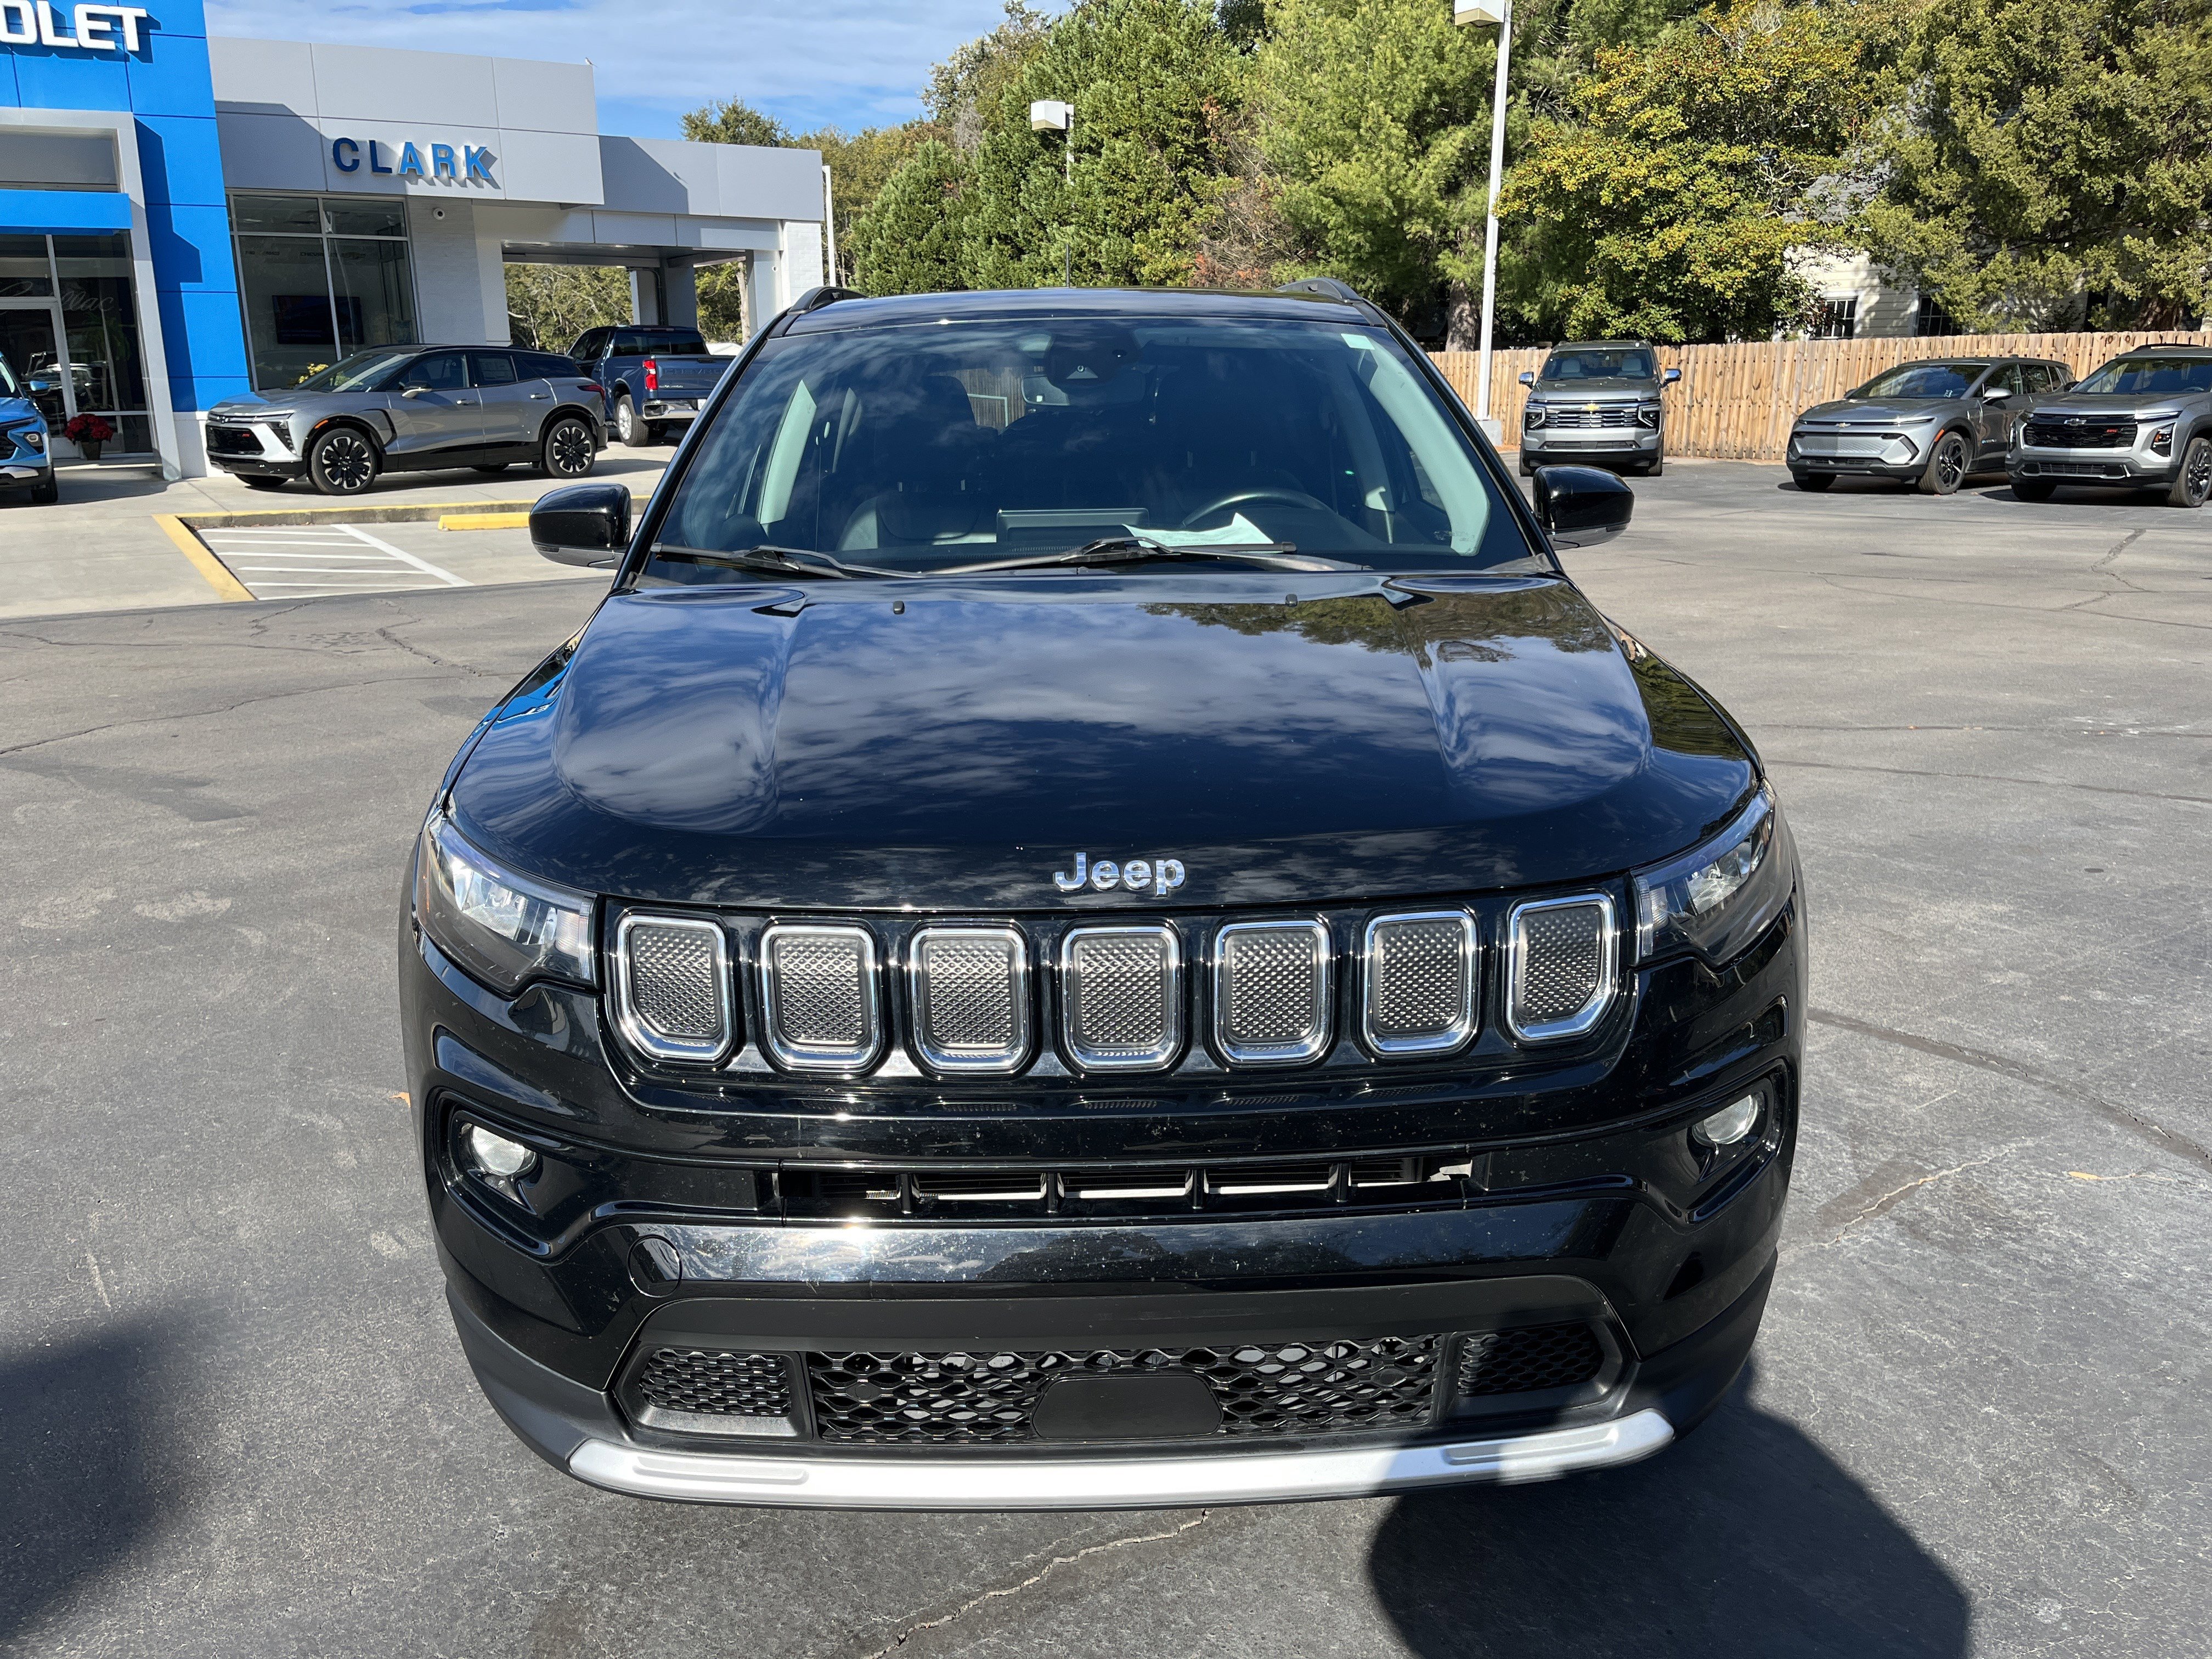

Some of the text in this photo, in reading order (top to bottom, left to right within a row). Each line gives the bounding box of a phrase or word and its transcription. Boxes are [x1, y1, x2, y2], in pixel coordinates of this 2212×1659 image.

[0, 0, 147, 52] OLET
[332, 137, 493, 179] CLARK
[1053, 852, 1186, 897] Jeep
